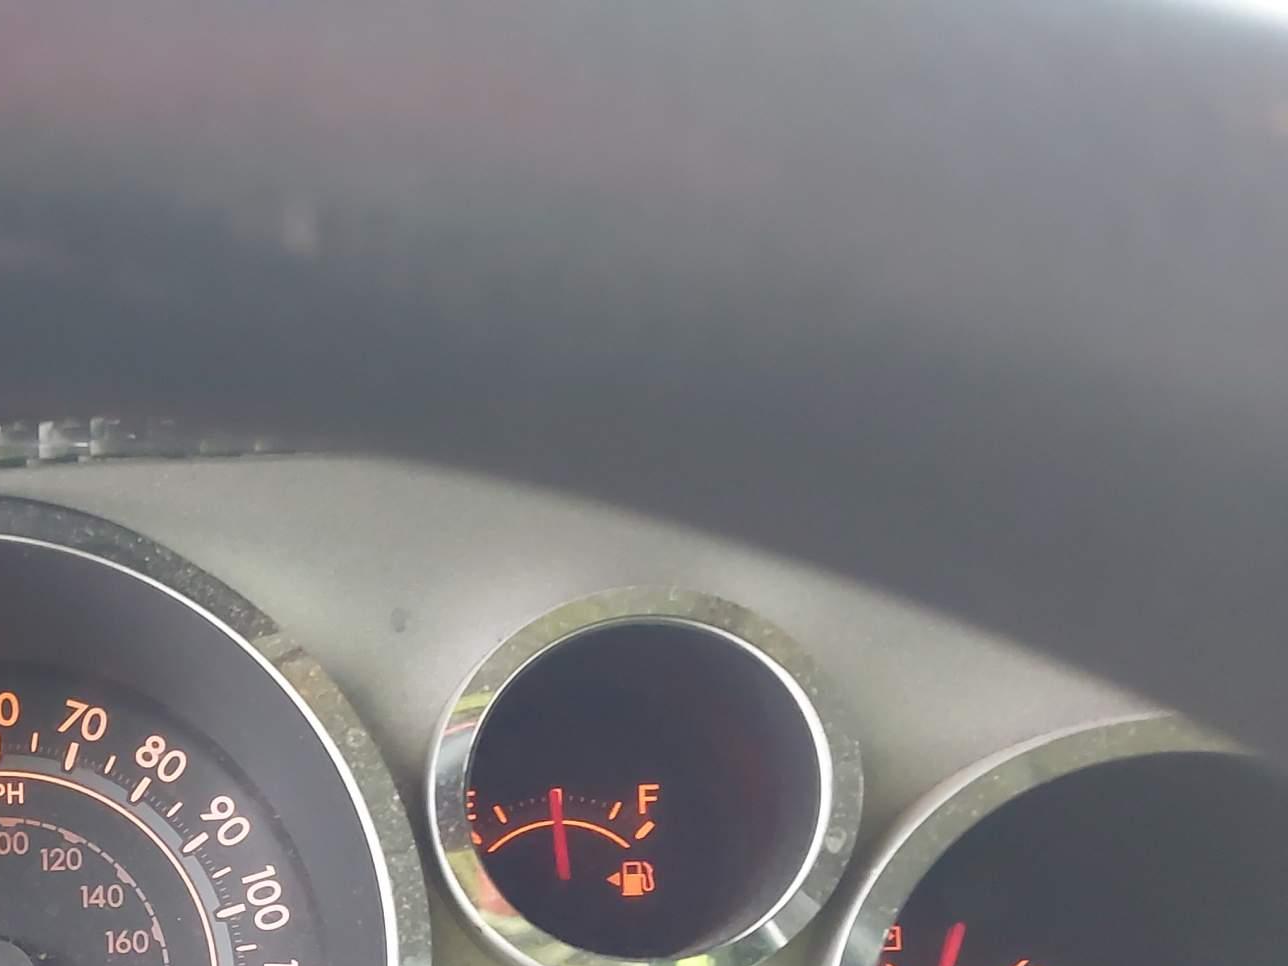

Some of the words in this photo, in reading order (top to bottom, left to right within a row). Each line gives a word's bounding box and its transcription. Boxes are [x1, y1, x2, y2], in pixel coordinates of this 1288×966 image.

[58, 699, 108, 741] 70
[135, 735, 187, 782] 80
[638, 784, 660, 814] F
[199, 795, 251, 846] 90
[40, 848, 82, 871] 120
[80, 884, 124, 908] 140
[241, 864, 290, 931] 100
[105, 930, 150, 954] 160
